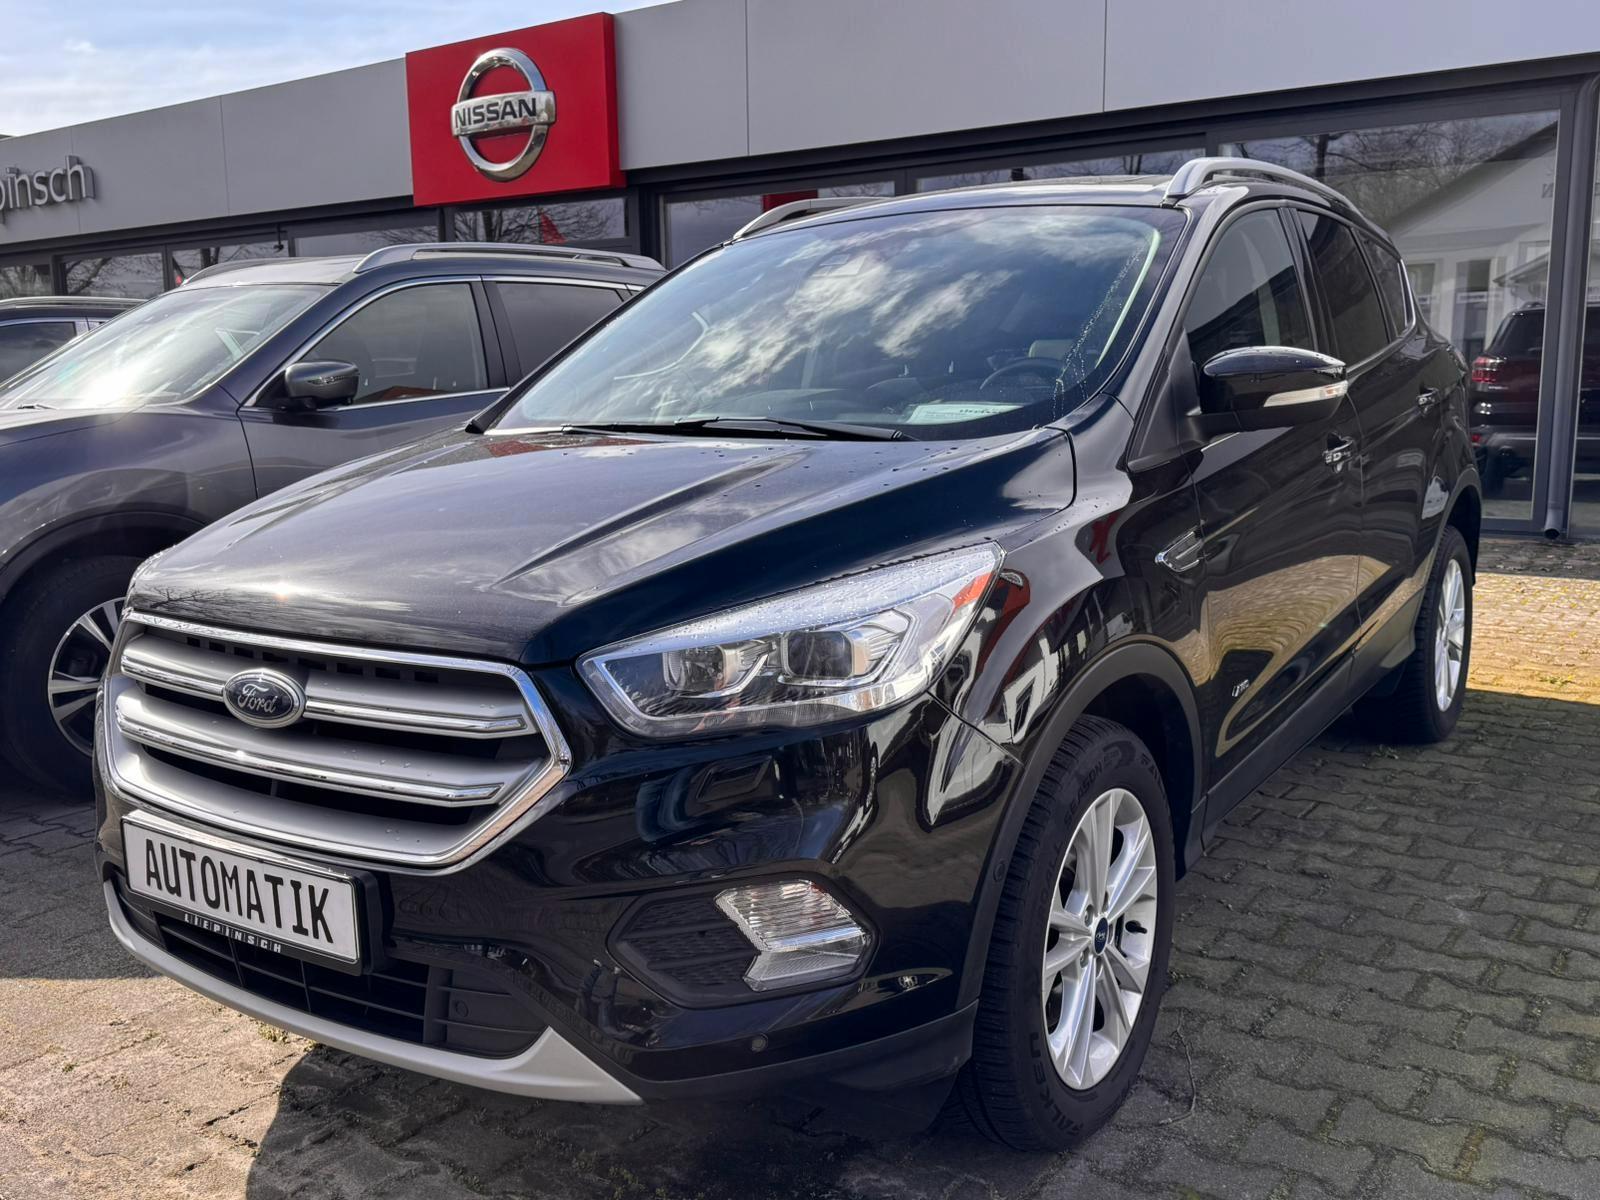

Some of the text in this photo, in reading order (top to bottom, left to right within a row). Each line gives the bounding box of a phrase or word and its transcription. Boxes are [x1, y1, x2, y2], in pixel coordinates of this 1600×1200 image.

[455, 98, 537, 128] NISSAN
[238, 683, 278, 713] Ford
[146, 838, 334, 944] AUTOMATIK
[184, 912, 282, 953] LIEPINSCH
